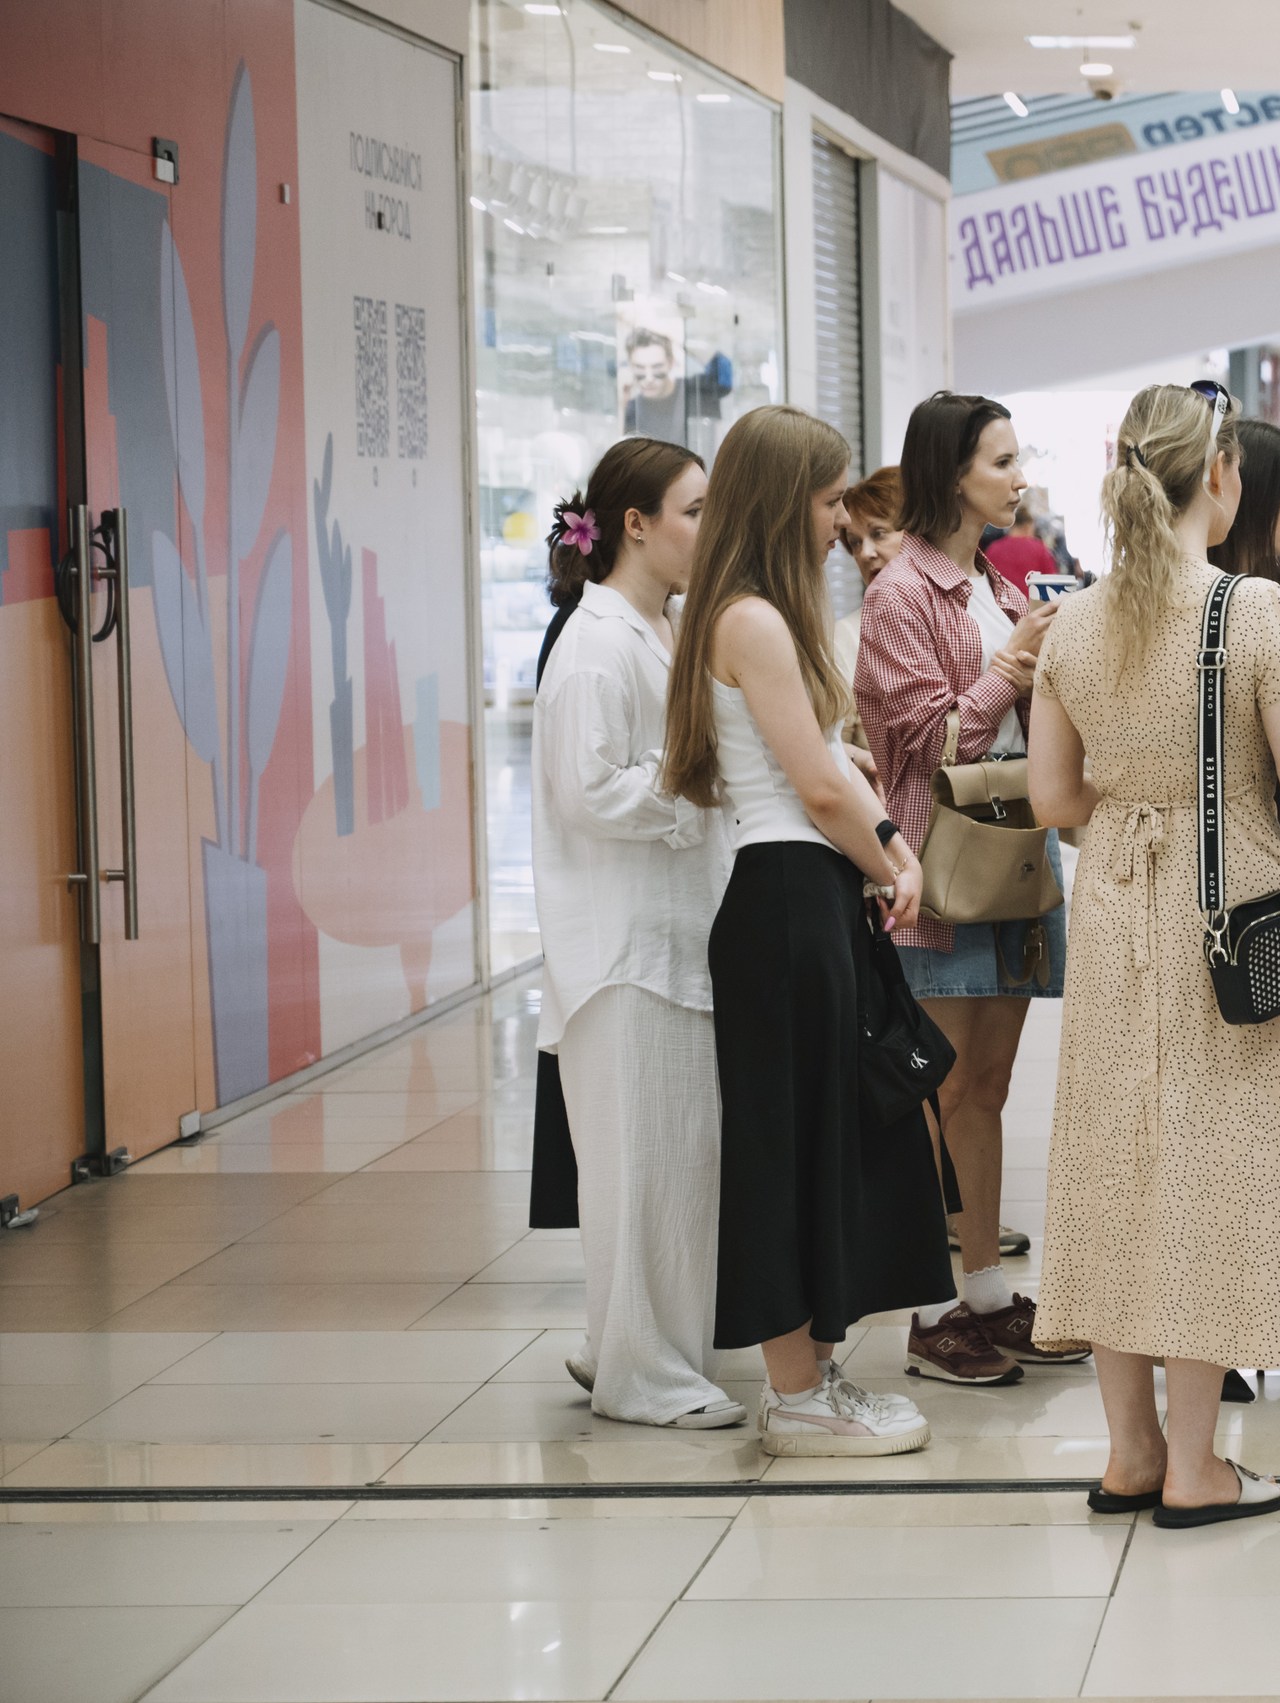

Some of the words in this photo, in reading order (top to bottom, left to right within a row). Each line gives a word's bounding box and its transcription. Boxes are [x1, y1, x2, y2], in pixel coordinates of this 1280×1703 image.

[959, 185, 1127, 291] ДАЛЬШЕ
[1209, 611, 1219, 634] TED
[1206, 757, 1215, 799] BAKER
[1206, 808, 1216, 833] TED
